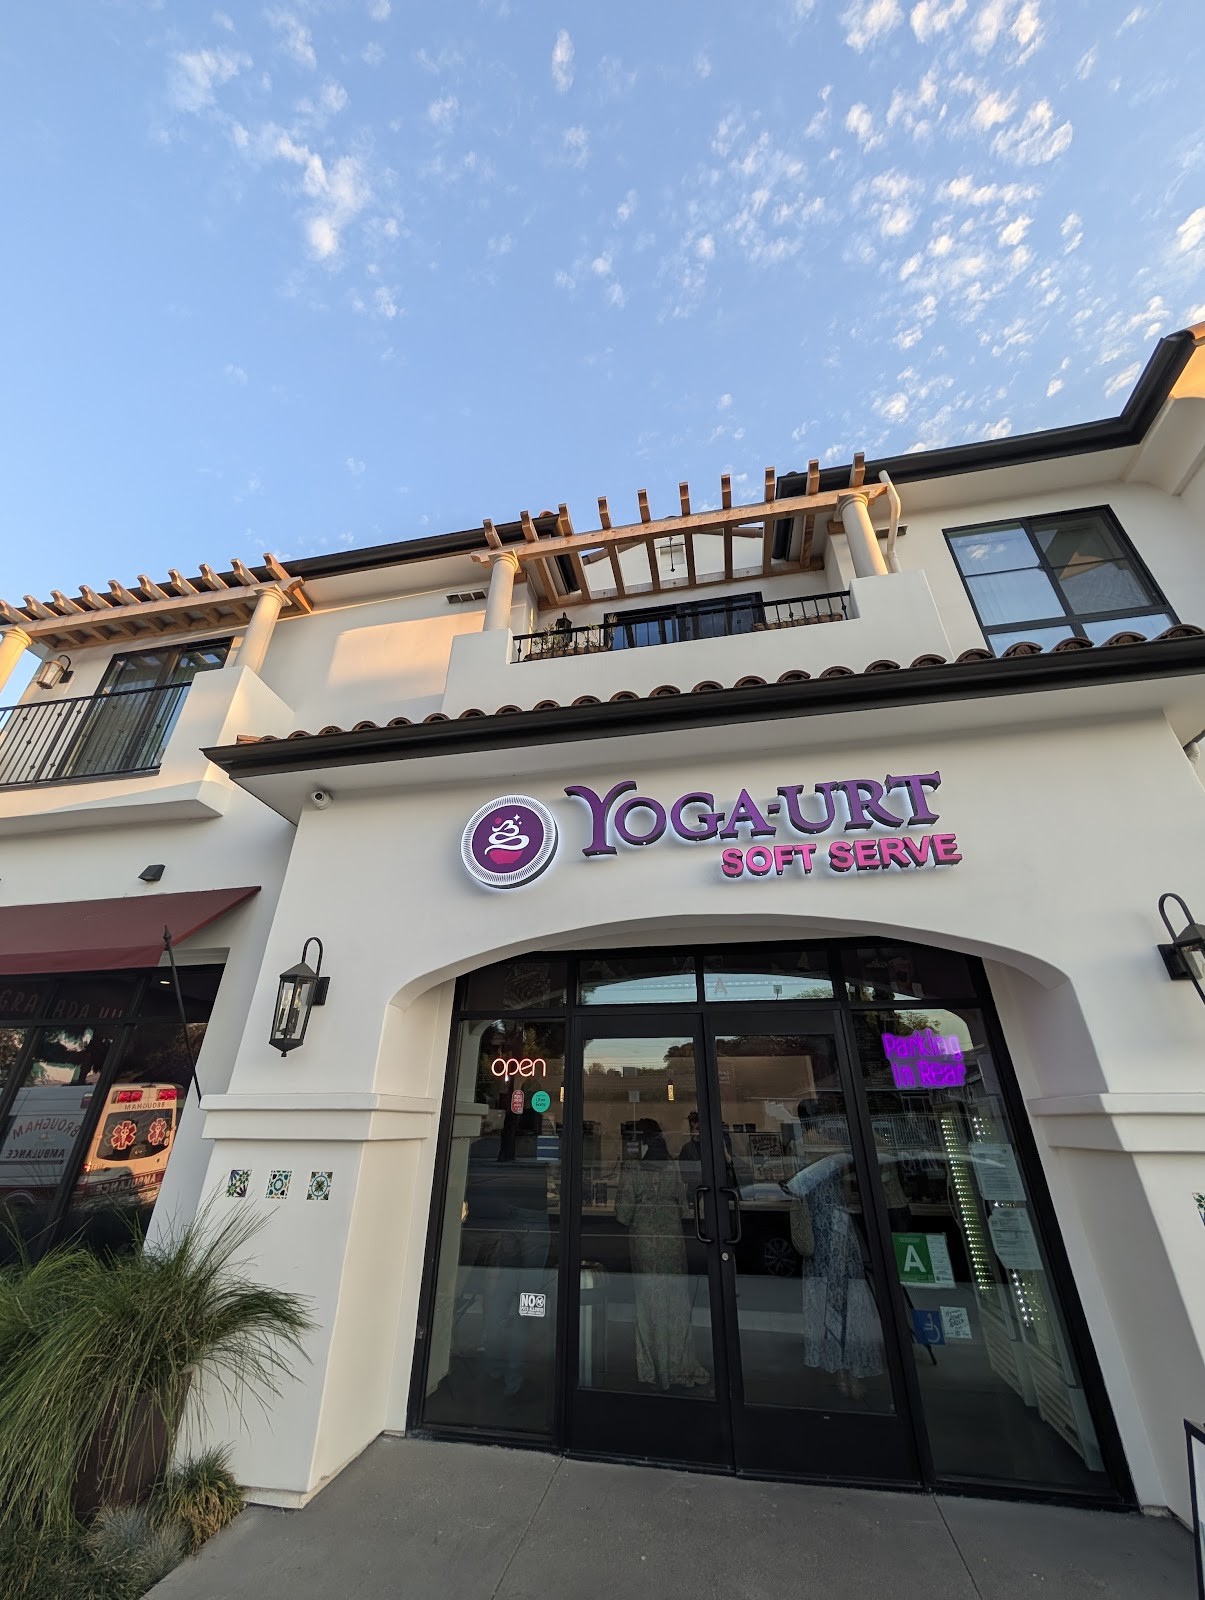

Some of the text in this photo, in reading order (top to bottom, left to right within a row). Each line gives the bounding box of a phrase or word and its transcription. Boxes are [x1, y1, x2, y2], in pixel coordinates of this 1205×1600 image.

[564, 770, 942, 858] YOGA-URT
[721, 833, 963, 878] SOFT SERVE
[491, 1058, 547, 1082] open
[918, 1060, 965, 1087] Rear
[904, 1245, 927, 1273] A
[521, 1294, 536, 1307] NO
